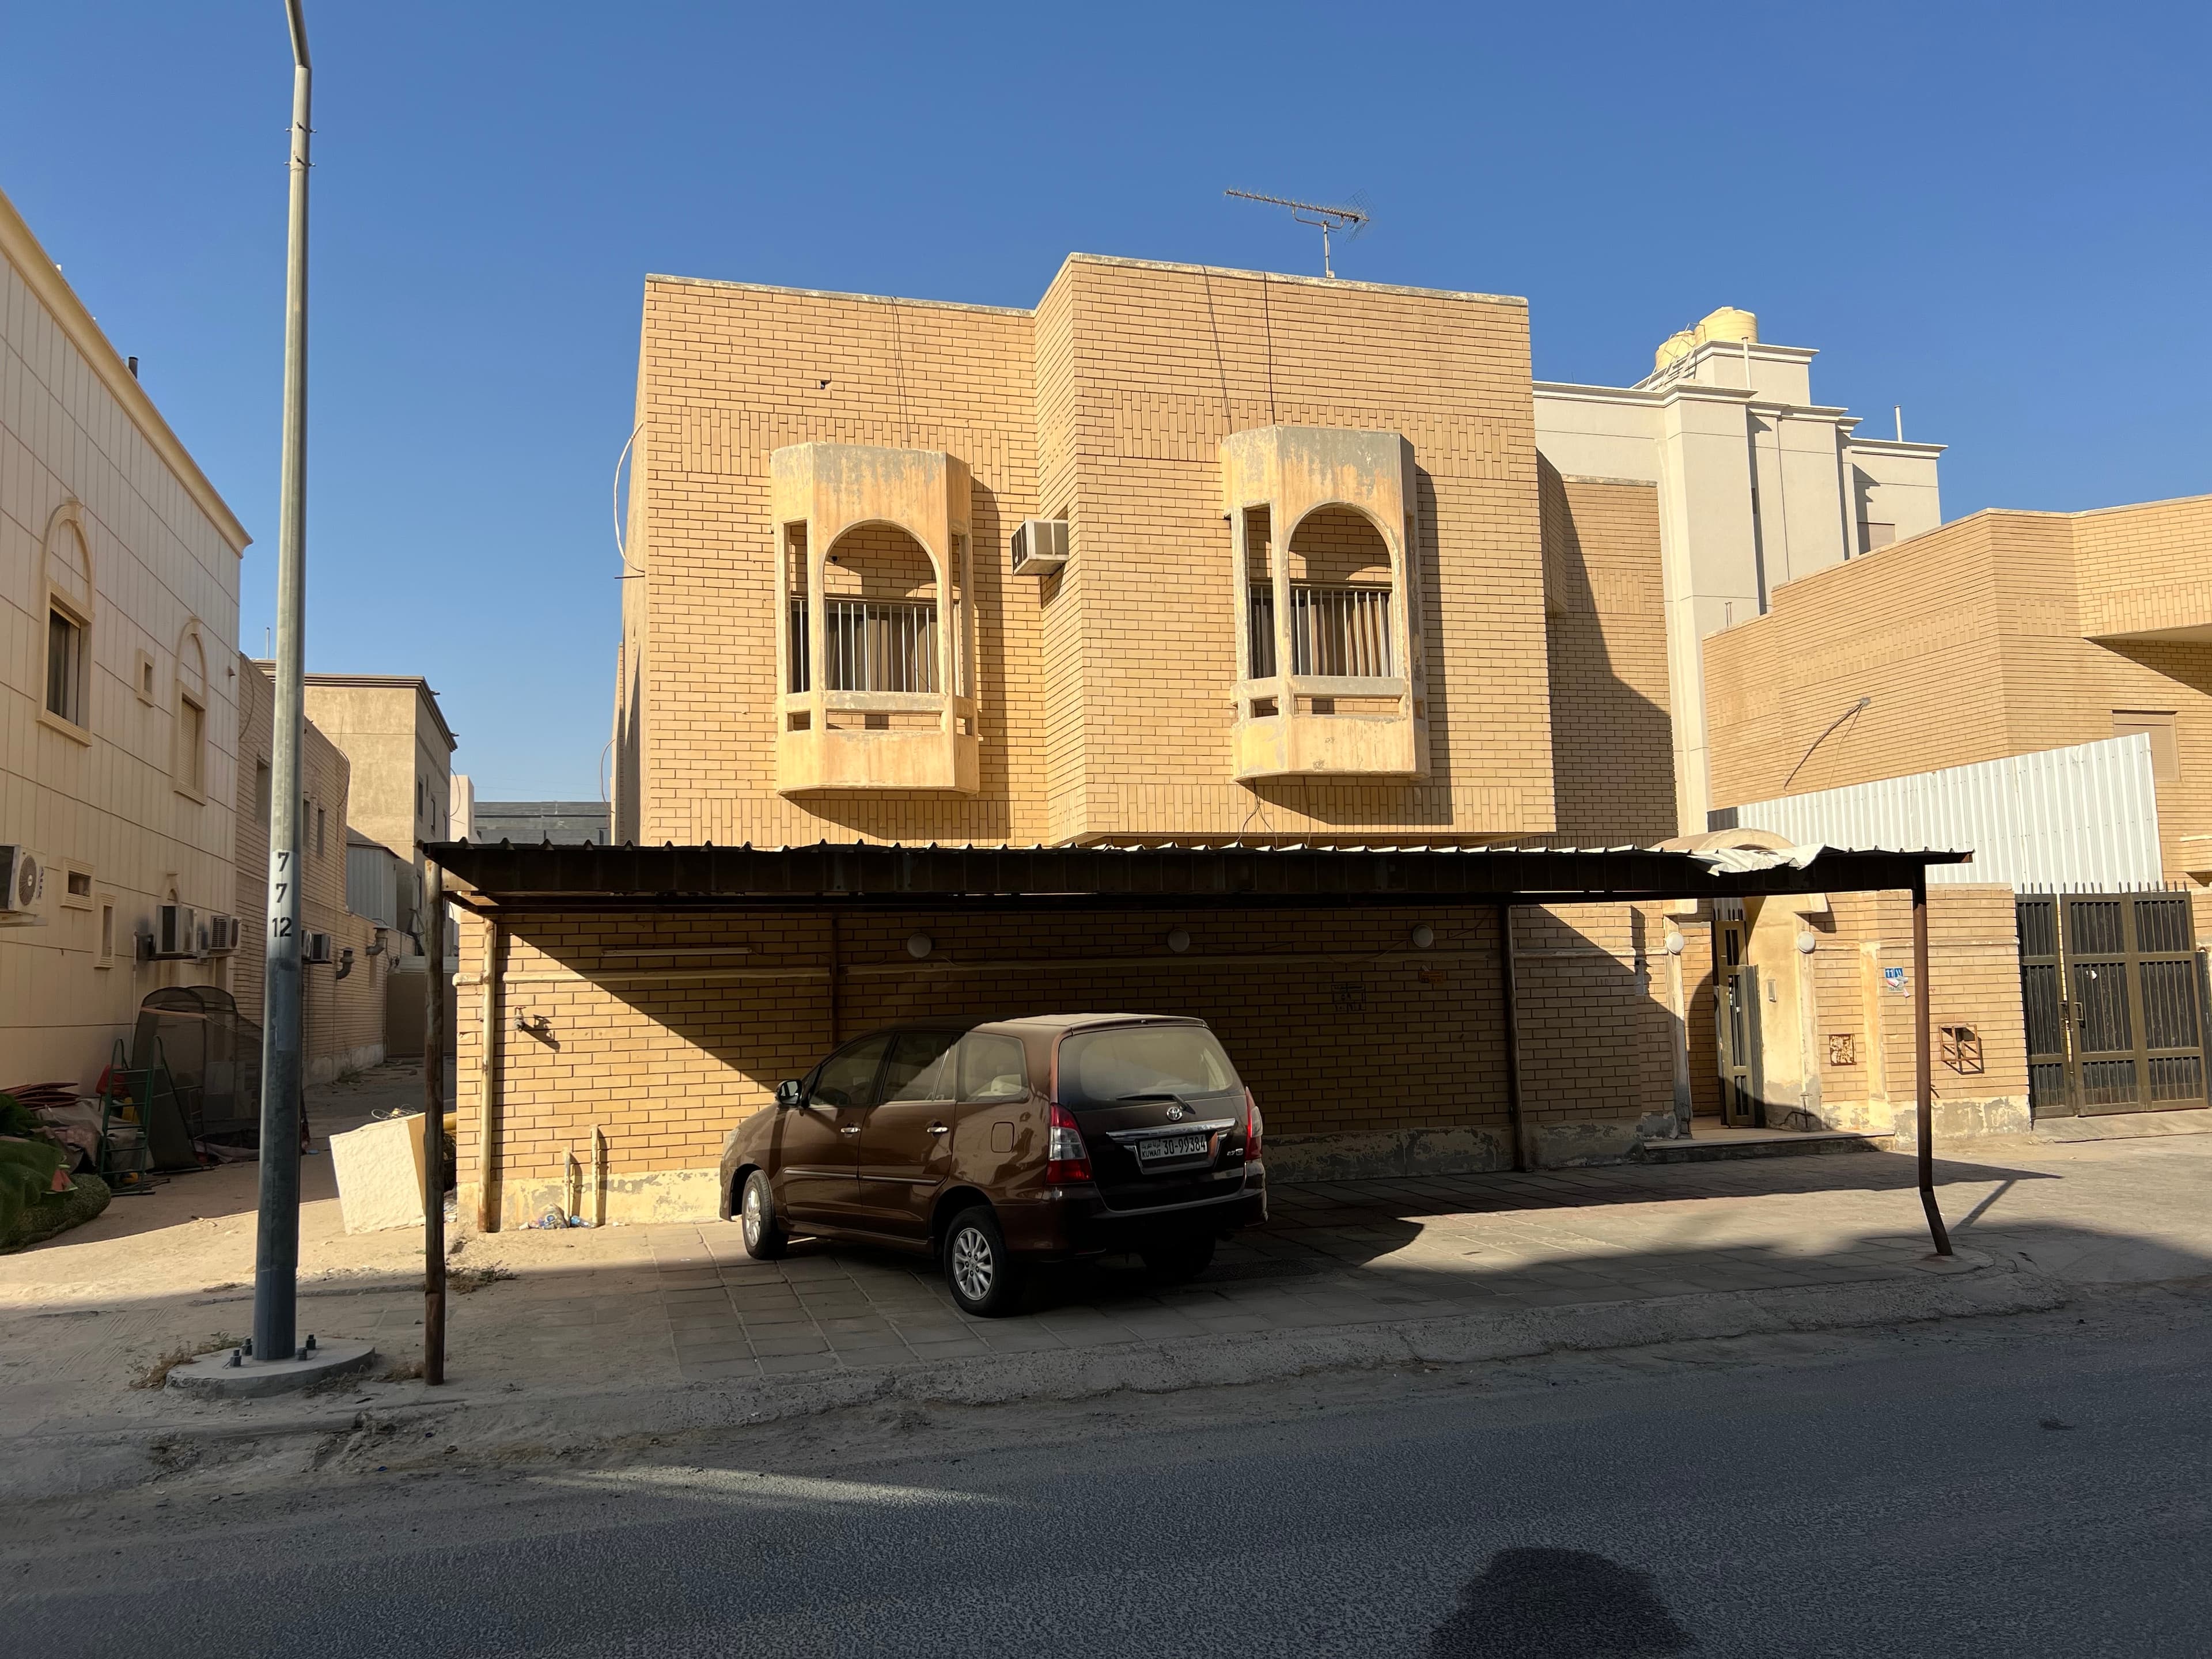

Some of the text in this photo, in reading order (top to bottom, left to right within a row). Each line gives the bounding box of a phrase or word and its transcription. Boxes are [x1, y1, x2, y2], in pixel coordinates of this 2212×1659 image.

[278, 852, 289, 872] 7
[276, 883, 287, 903] 7
[272, 916, 292, 937] 12
[1885, 969, 1893, 978] 11
[1142, 1149, 1161, 1158] KUWAIT
[1164, 1135, 1206, 1155] 30-99384
